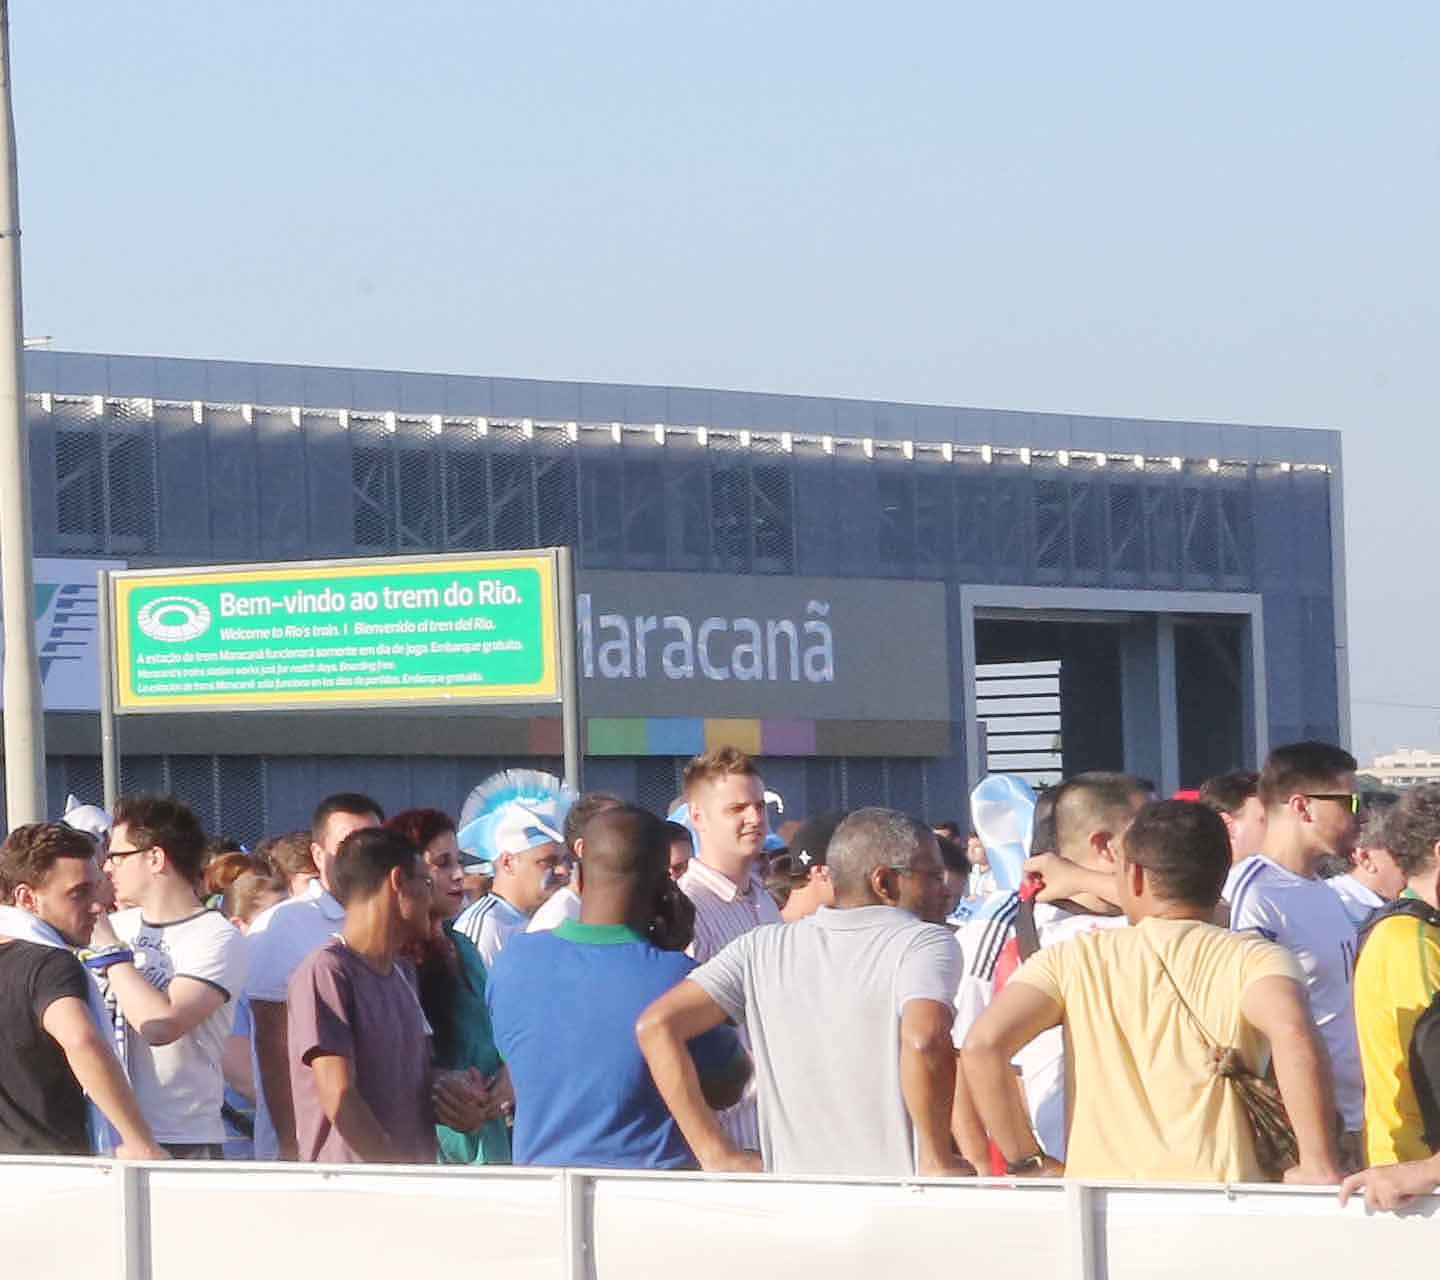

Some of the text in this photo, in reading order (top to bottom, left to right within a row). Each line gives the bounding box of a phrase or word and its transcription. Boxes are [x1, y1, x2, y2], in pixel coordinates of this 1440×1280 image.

[220, 580, 523, 617] Bem-vindo ao trem do Rio.
[220, 627, 270, 640] Welcome
[272, 627, 283, 638] to
[285, 625, 311, 638] Rio's
[354, 621, 416, 635] Bienvenido
